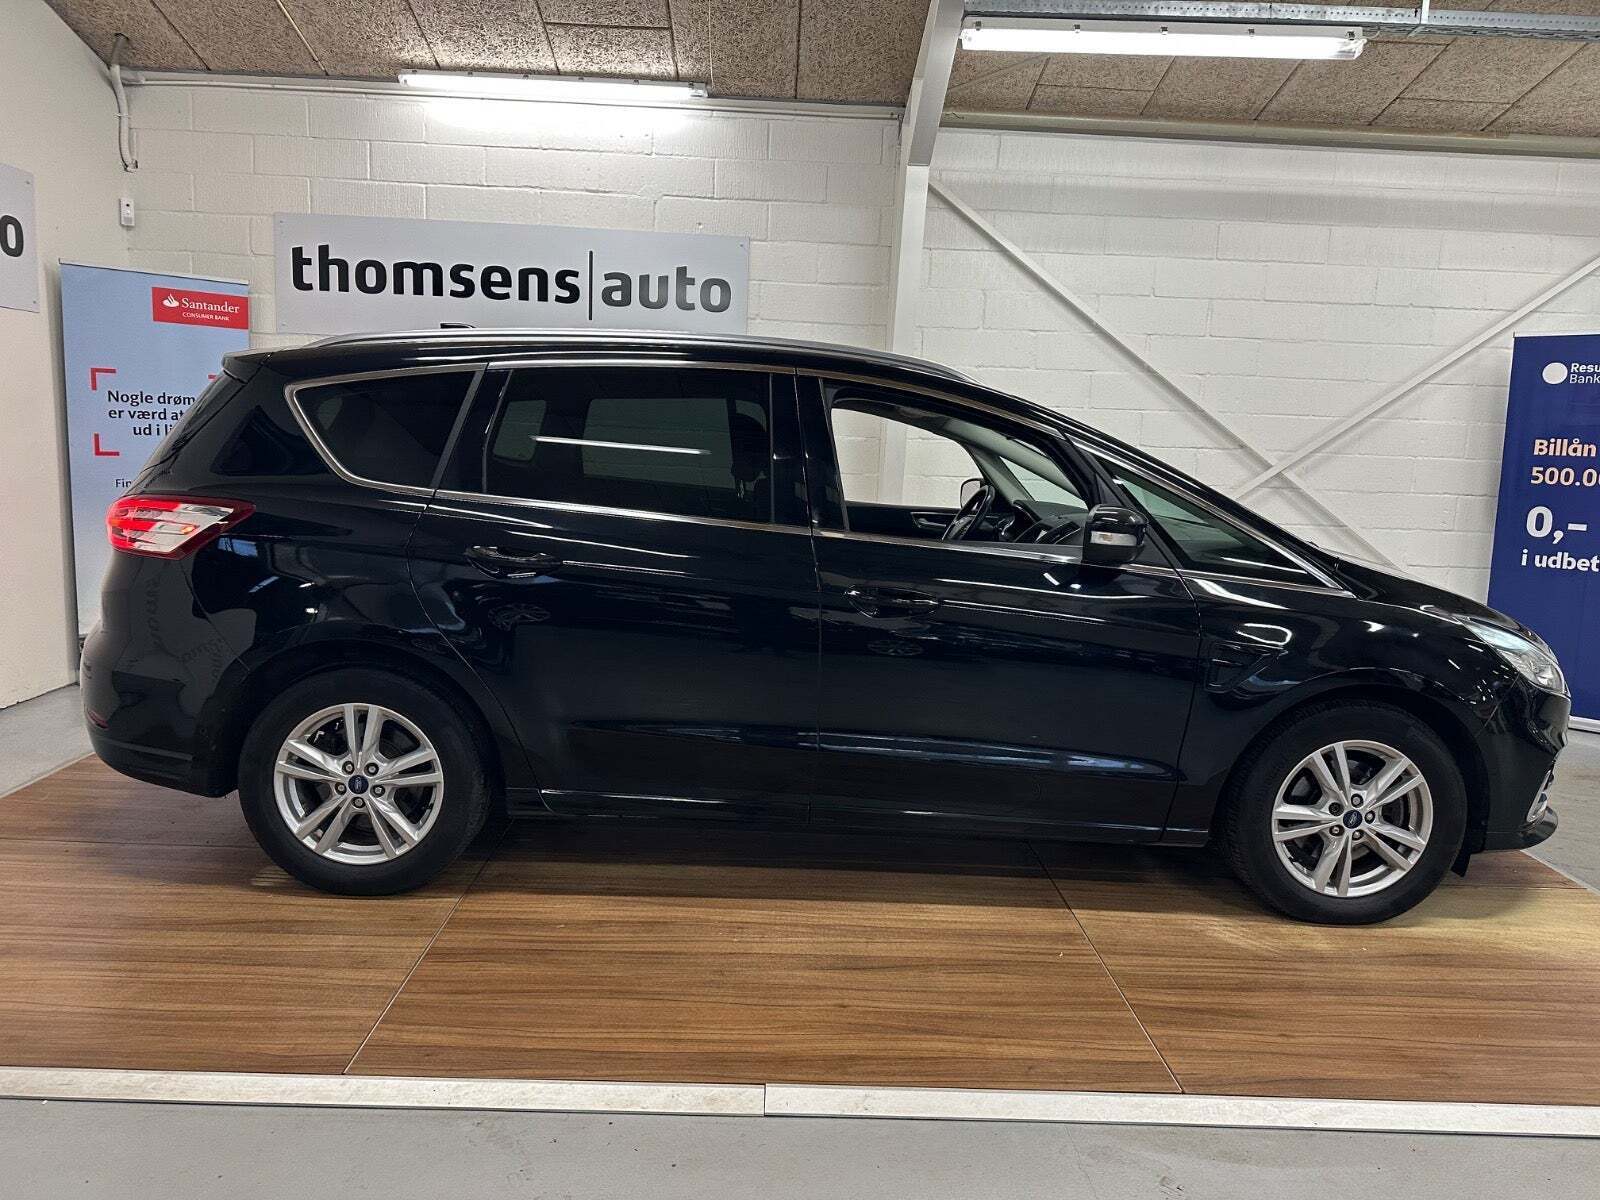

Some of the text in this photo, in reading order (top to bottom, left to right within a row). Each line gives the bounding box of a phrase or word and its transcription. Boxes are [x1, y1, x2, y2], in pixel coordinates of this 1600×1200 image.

[292, 244, 732, 313] thomsens auto
[181, 297, 240, 313] Santander
[182, 311, 214, 320] CONSUMER
[1570, 362, 1600, 373] Resu
[1569, 373, 1600, 384] Bank
[107, 390, 195, 407] Nogle drøm
[108, 409, 124, 419] er
[127, 407, 167, 421] værd
[133, 423, 152, 436] ud
[156, 423, 161, 436] i
[1533, 438, 1597, 457] Billån
[1530, 466, 1600, 487] 500.0
[1521, 548, 1600, 572] i udbet
